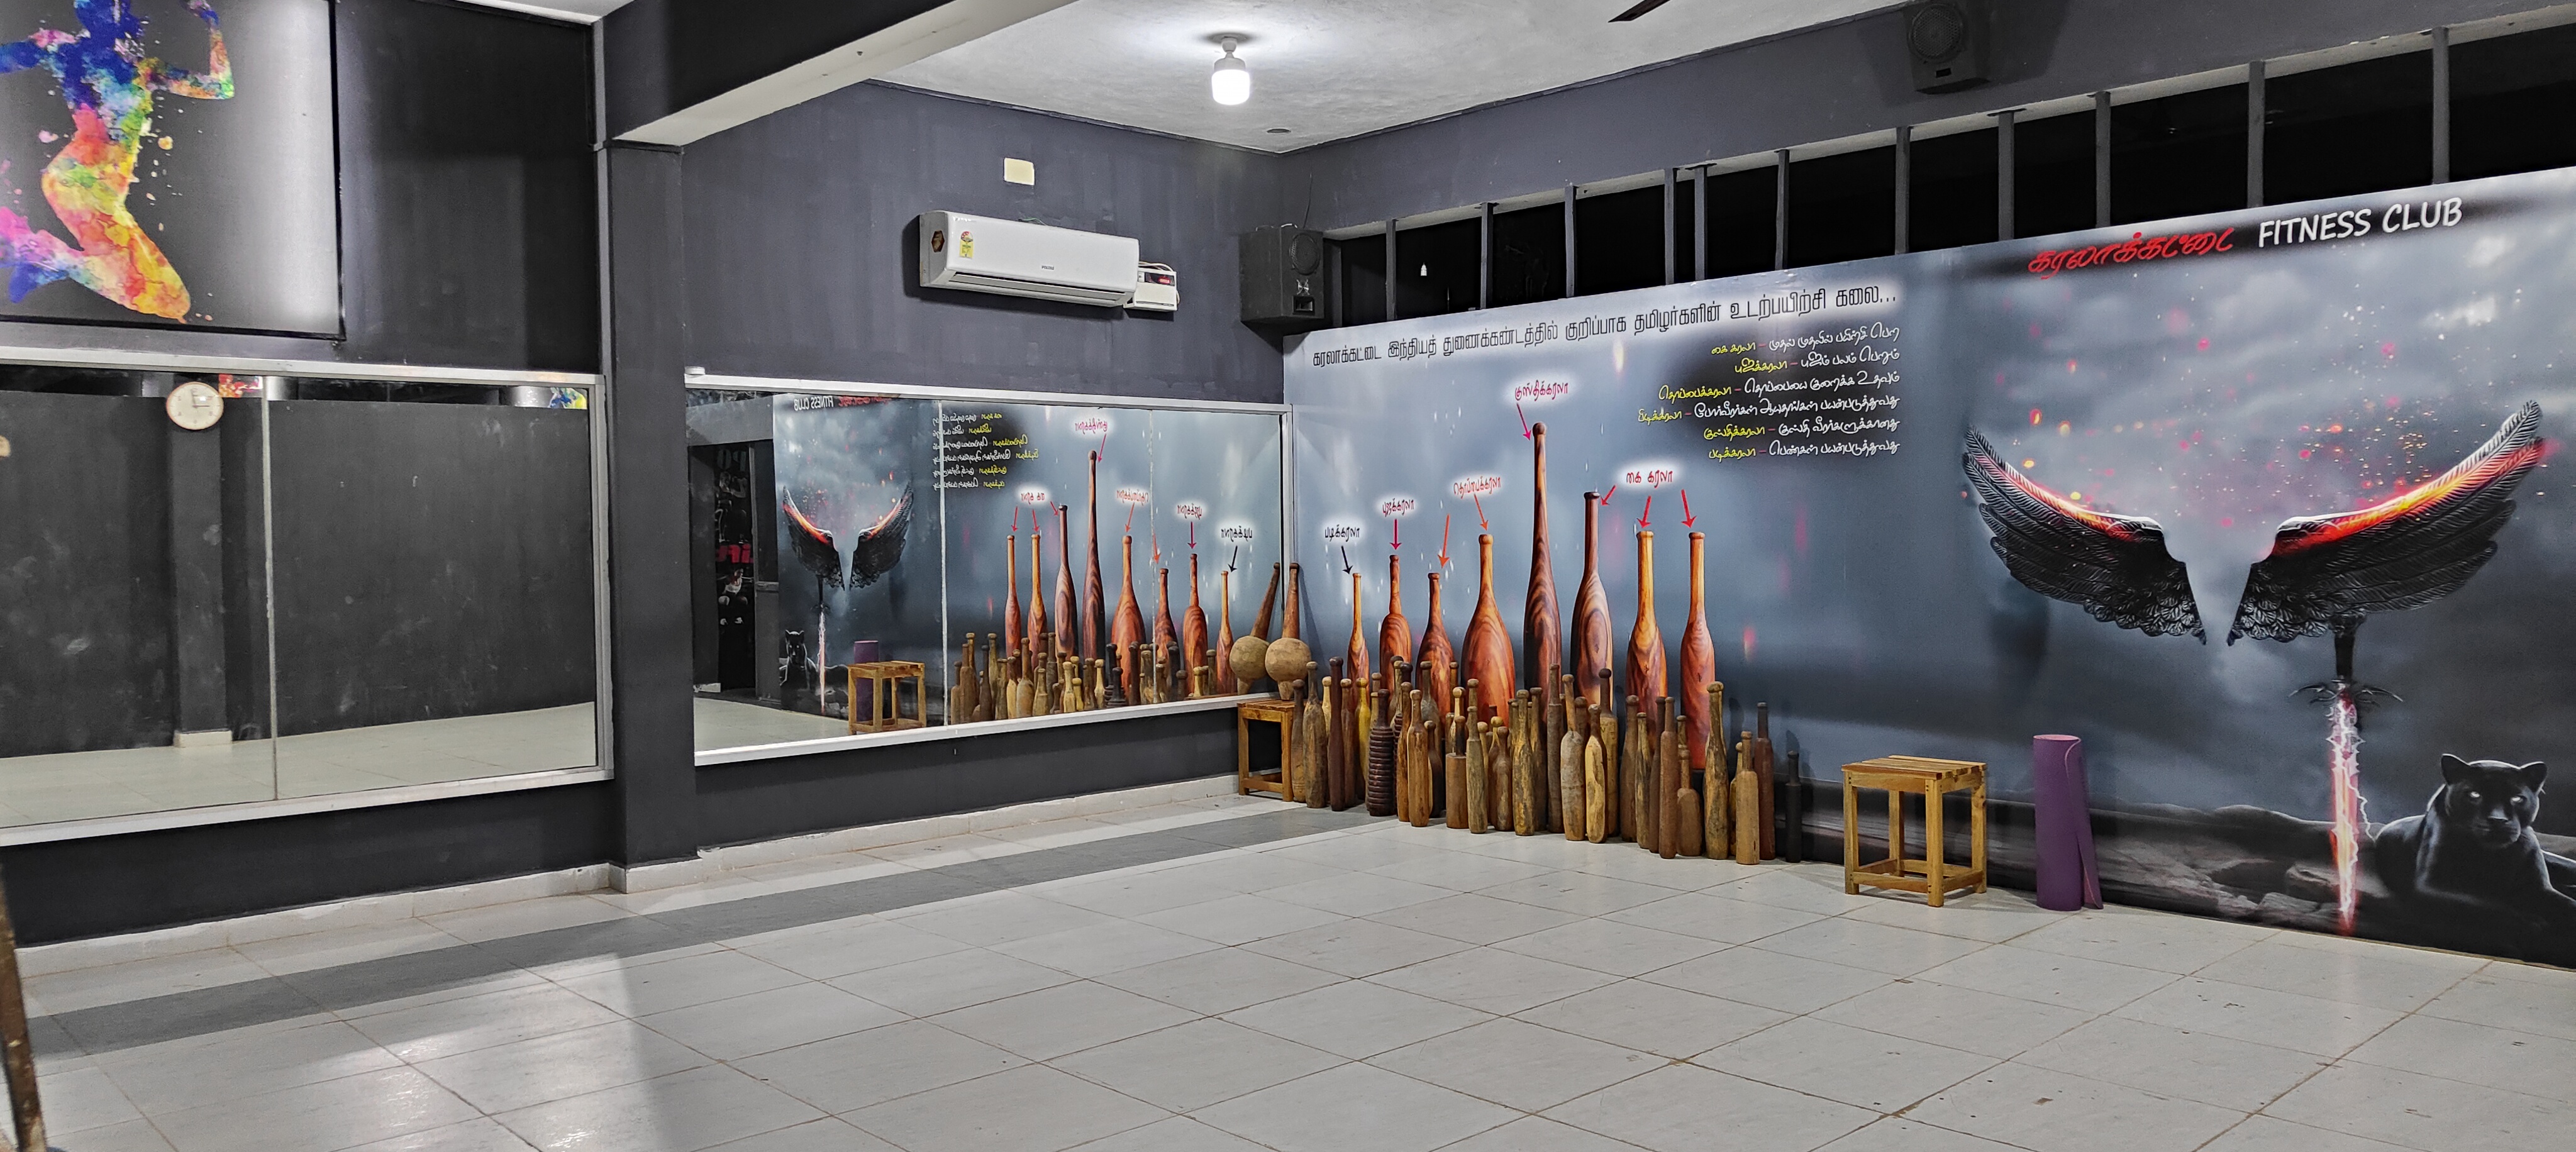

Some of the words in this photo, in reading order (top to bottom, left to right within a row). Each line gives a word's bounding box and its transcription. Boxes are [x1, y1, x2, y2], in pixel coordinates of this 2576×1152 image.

[2028, 226, 2234, 280] கரலாக்கட்டை
[2259, 208, 2372, 248] FITNESS
[2382, 197, 2462, 233] CLUB
[1313, 344, 1382, 367] கரலாக்கட்டை
[1387, 335, 1437, 361] இந்தியத்
[1443, 320, 1558, 357] துணைக்கண்டத்தில்
[1565, 315, 1626, 341] குறிப்பாக
[1634, 301, 1722, 336] தமிழர்களின்
[1730, 288, 1826, 321] உடற்பயிற்சி
[1711, 345, 1728, 355] கை
[1729, 342, 1756, 355] கரலா
[1769, 338, 1796, 353] முதல்
[1797, 330, 1833, 350] முதலில்
[1835, 326, 1868, 346] பயிற்சி
[1870, 321, 1900, 342] பெற
[1735, 357, 1787, 374] புஜக்கரலா
[1801, 351, 1830, 368] புஜம்
[1832, 352, 1857, 365] பலம்
[1859, 345, 1900, 365] பெறும்
[1514, 379, 1568, 401] குஸ்திக்கரலா
[1658, 384, 1732, 404] தொப்பைக்கரலா
[1744, 377, 1807, 398] தொப்பையை
[1809, 374, 1855, 392] குறைக்க
[1857, 370, 1900, 389] உதவும்
[1638, 408, 1682, 425] பிடிக்கரலா
[1820, 394, 1901, 413] பயன்படுத்துவது
[1704, 424, 1765, 441] குஸ்திக்கரலா
[1778, 419, 1810, 438] குஸ்தி
[1708, 446, 1757, 462] படிக்கரலா
[1768, 440, 1818, 457] பெண்கள்
[1820, 440, 1901, 457] பயன்படுத்துவது
[1453, 475, 1501, 499] தொப்பைக்கரலா
[1626, 471, 1641, 484] கை
[1647, 470, 1673, 488] கரலா
[1324, 524, 1360, 542] படிக்கரலா
